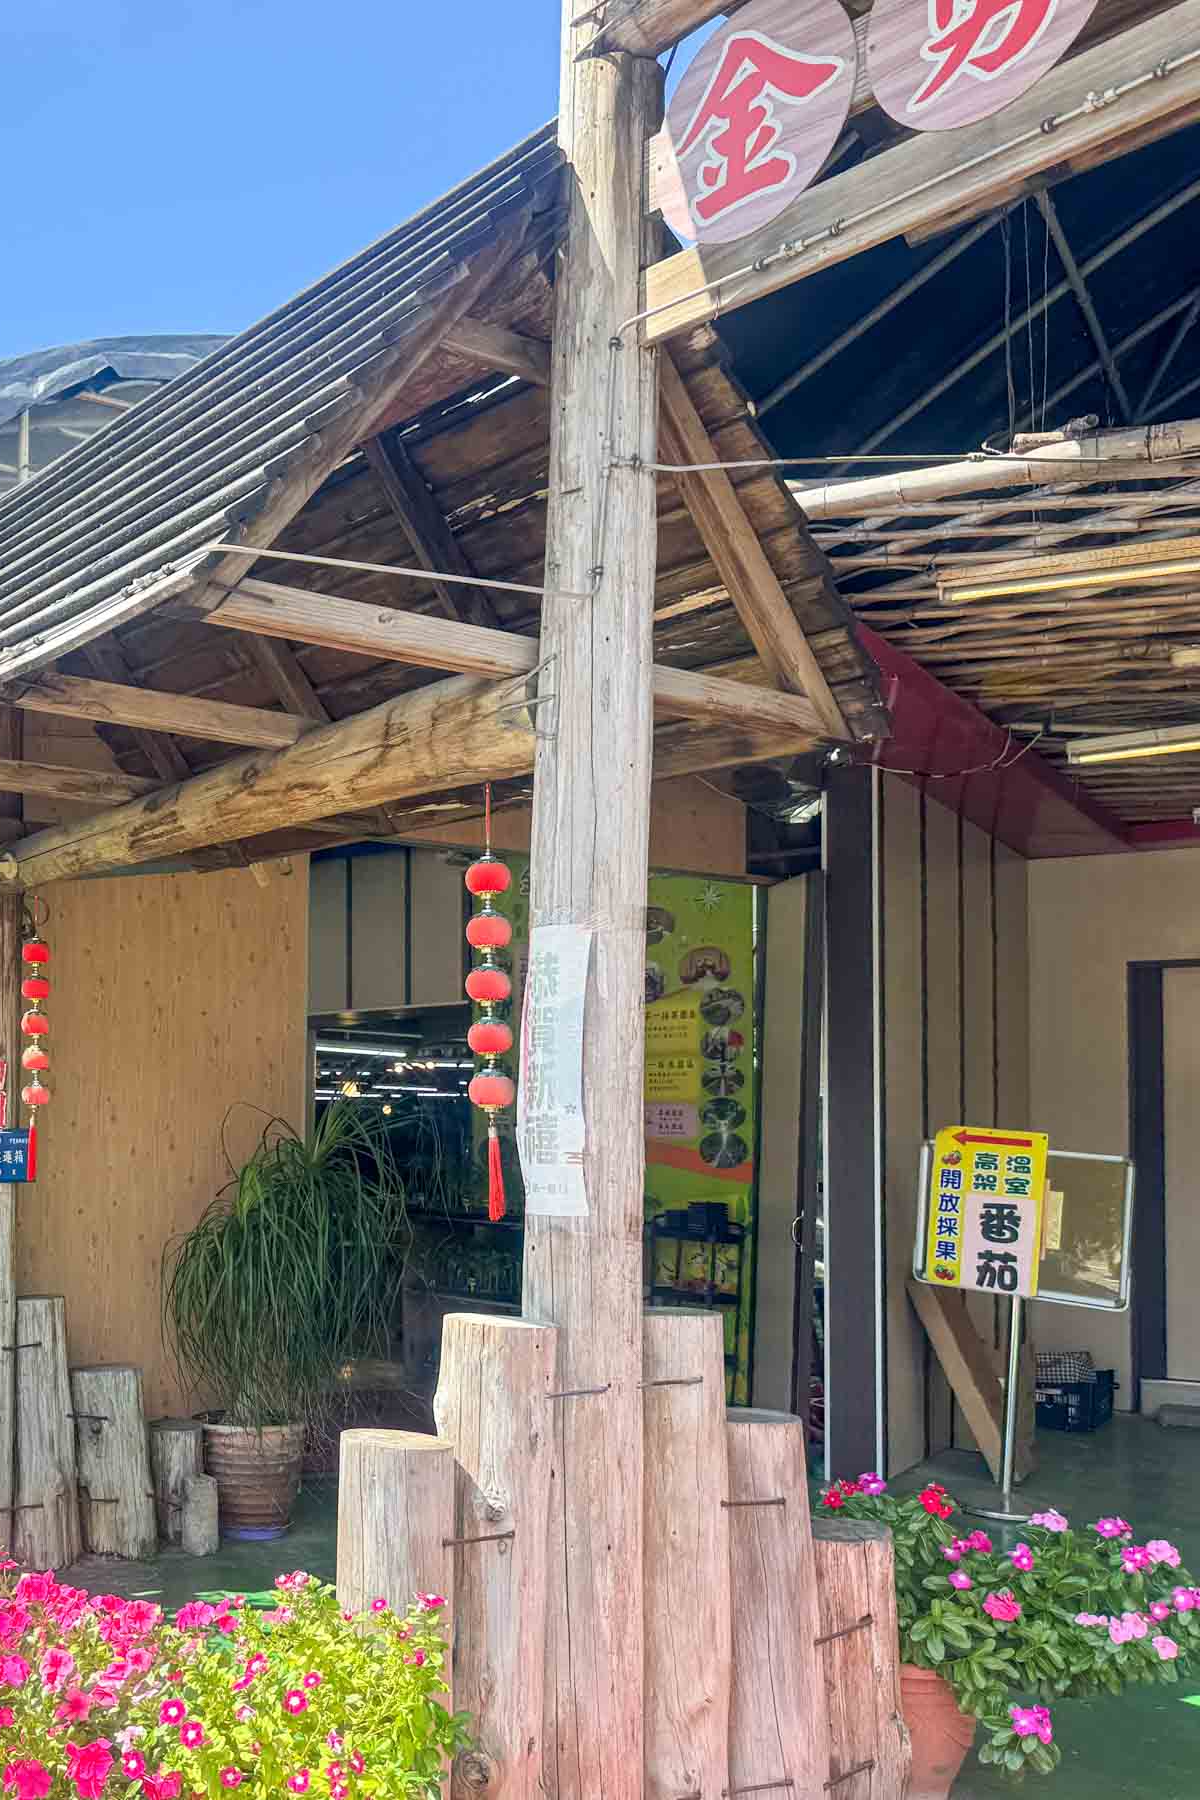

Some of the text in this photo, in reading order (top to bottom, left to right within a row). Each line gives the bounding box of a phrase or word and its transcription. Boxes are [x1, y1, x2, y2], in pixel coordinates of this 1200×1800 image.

[934, 1168, 962, 1262] 開放採果
[1004, 1155, 1032, 1196] 溫室
[976, 1202, 1022, 1292] 番茄
